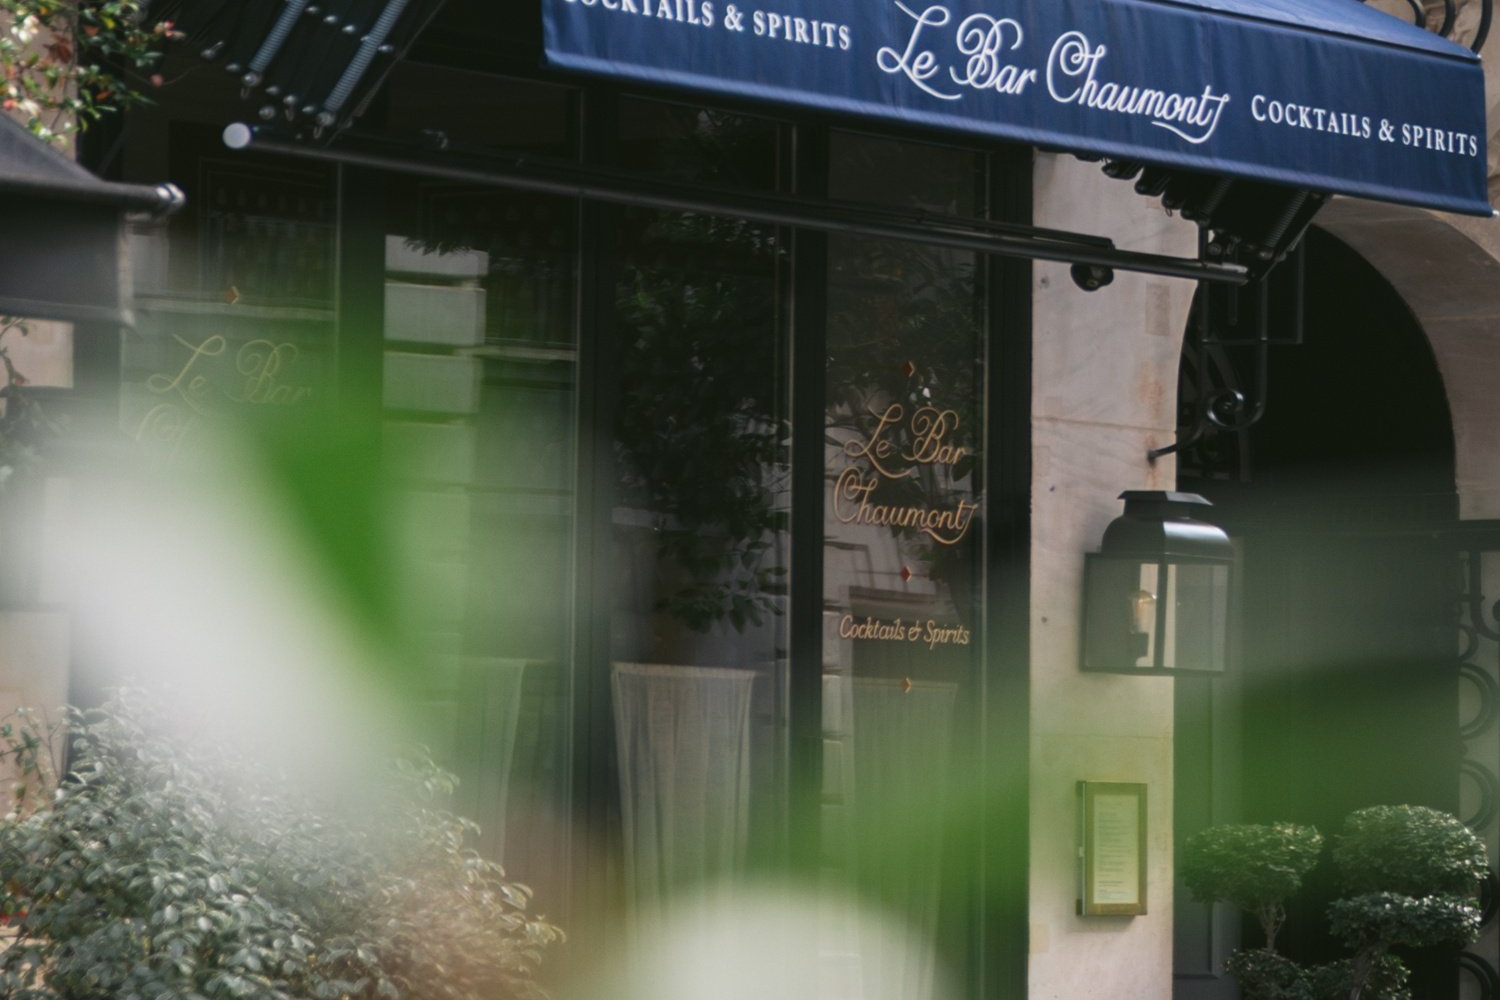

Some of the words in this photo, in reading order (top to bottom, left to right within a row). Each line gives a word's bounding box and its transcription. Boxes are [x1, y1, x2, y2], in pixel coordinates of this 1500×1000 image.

[723, 3, 745, 33] &
[753, 10, 852, 51] SPIRITS
[876, 0, 962, 101] Le
[949, 12, 1037, 96] Bar
[1046, 30, 1230, 144] Chaumont
[1251, 94, 1371, 141] COCKTAILS
[1378, 118, 1396, 143] &
[1401, 122, 1478, 157] SPIRITS
[844, 403, 912, 478] Le
[901, 406, 967, 464] Bar
[834, 467, 978, 545] Chaumont
[839, 614, 904, 642] Cocktails
[908, 624, 921, 642] &
[923, 620, 970, 650] Spirits
